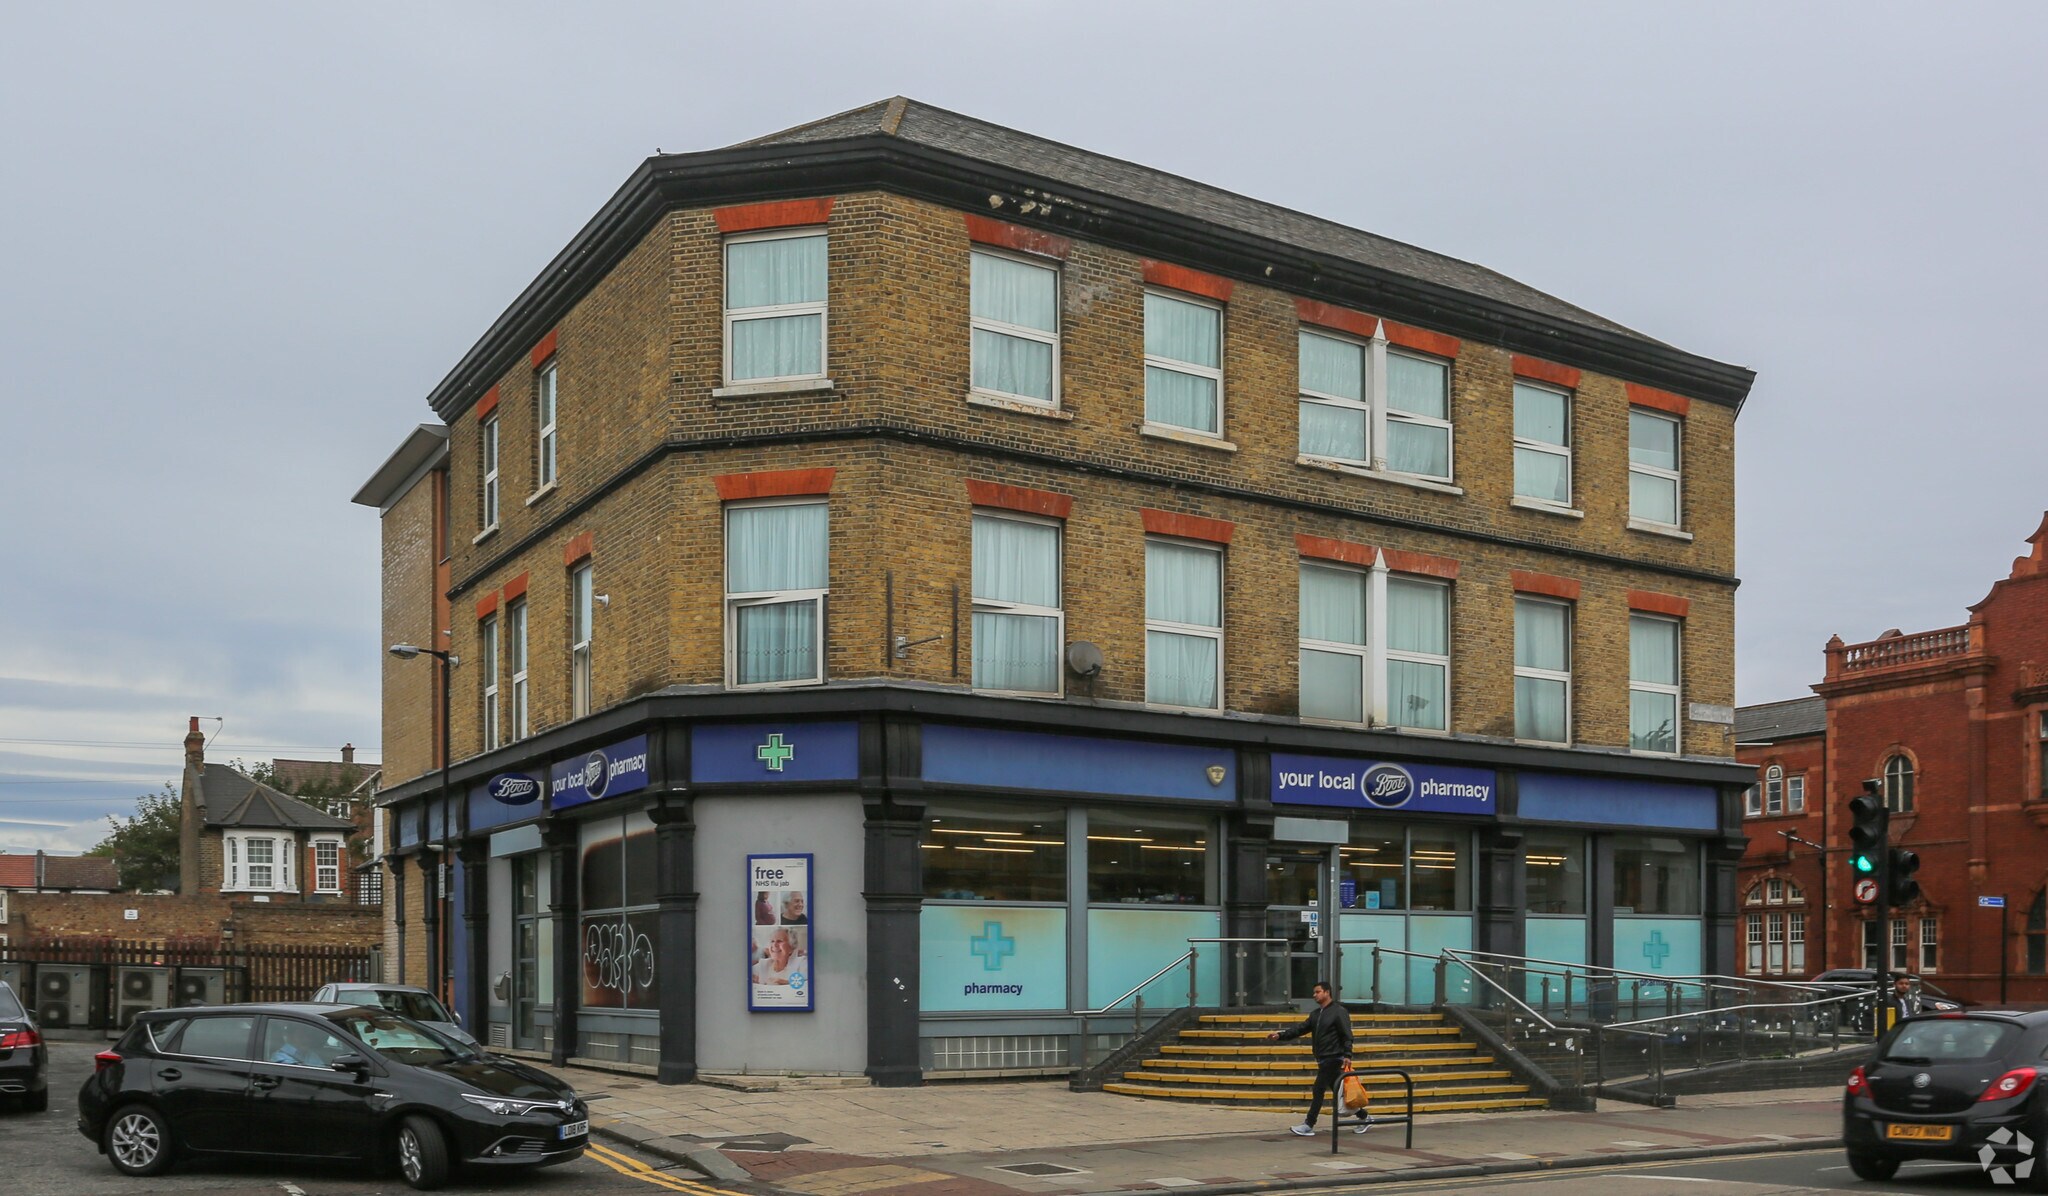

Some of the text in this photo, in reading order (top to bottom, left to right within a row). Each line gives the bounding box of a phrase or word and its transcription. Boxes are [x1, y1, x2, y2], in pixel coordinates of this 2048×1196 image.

[552, 775, 566, 796] your
[568, 768, 584, 789] local
[610, 752, 647, 781] pharmacy
[495, 777, 534, 798] Boots
[1279, 770, 1490, 802] your local Boots pharmacy
[755, 866, 784, 880] free
[779, 880, 790, 888] jab
[964, 982, 1023, 996] pharmacy
